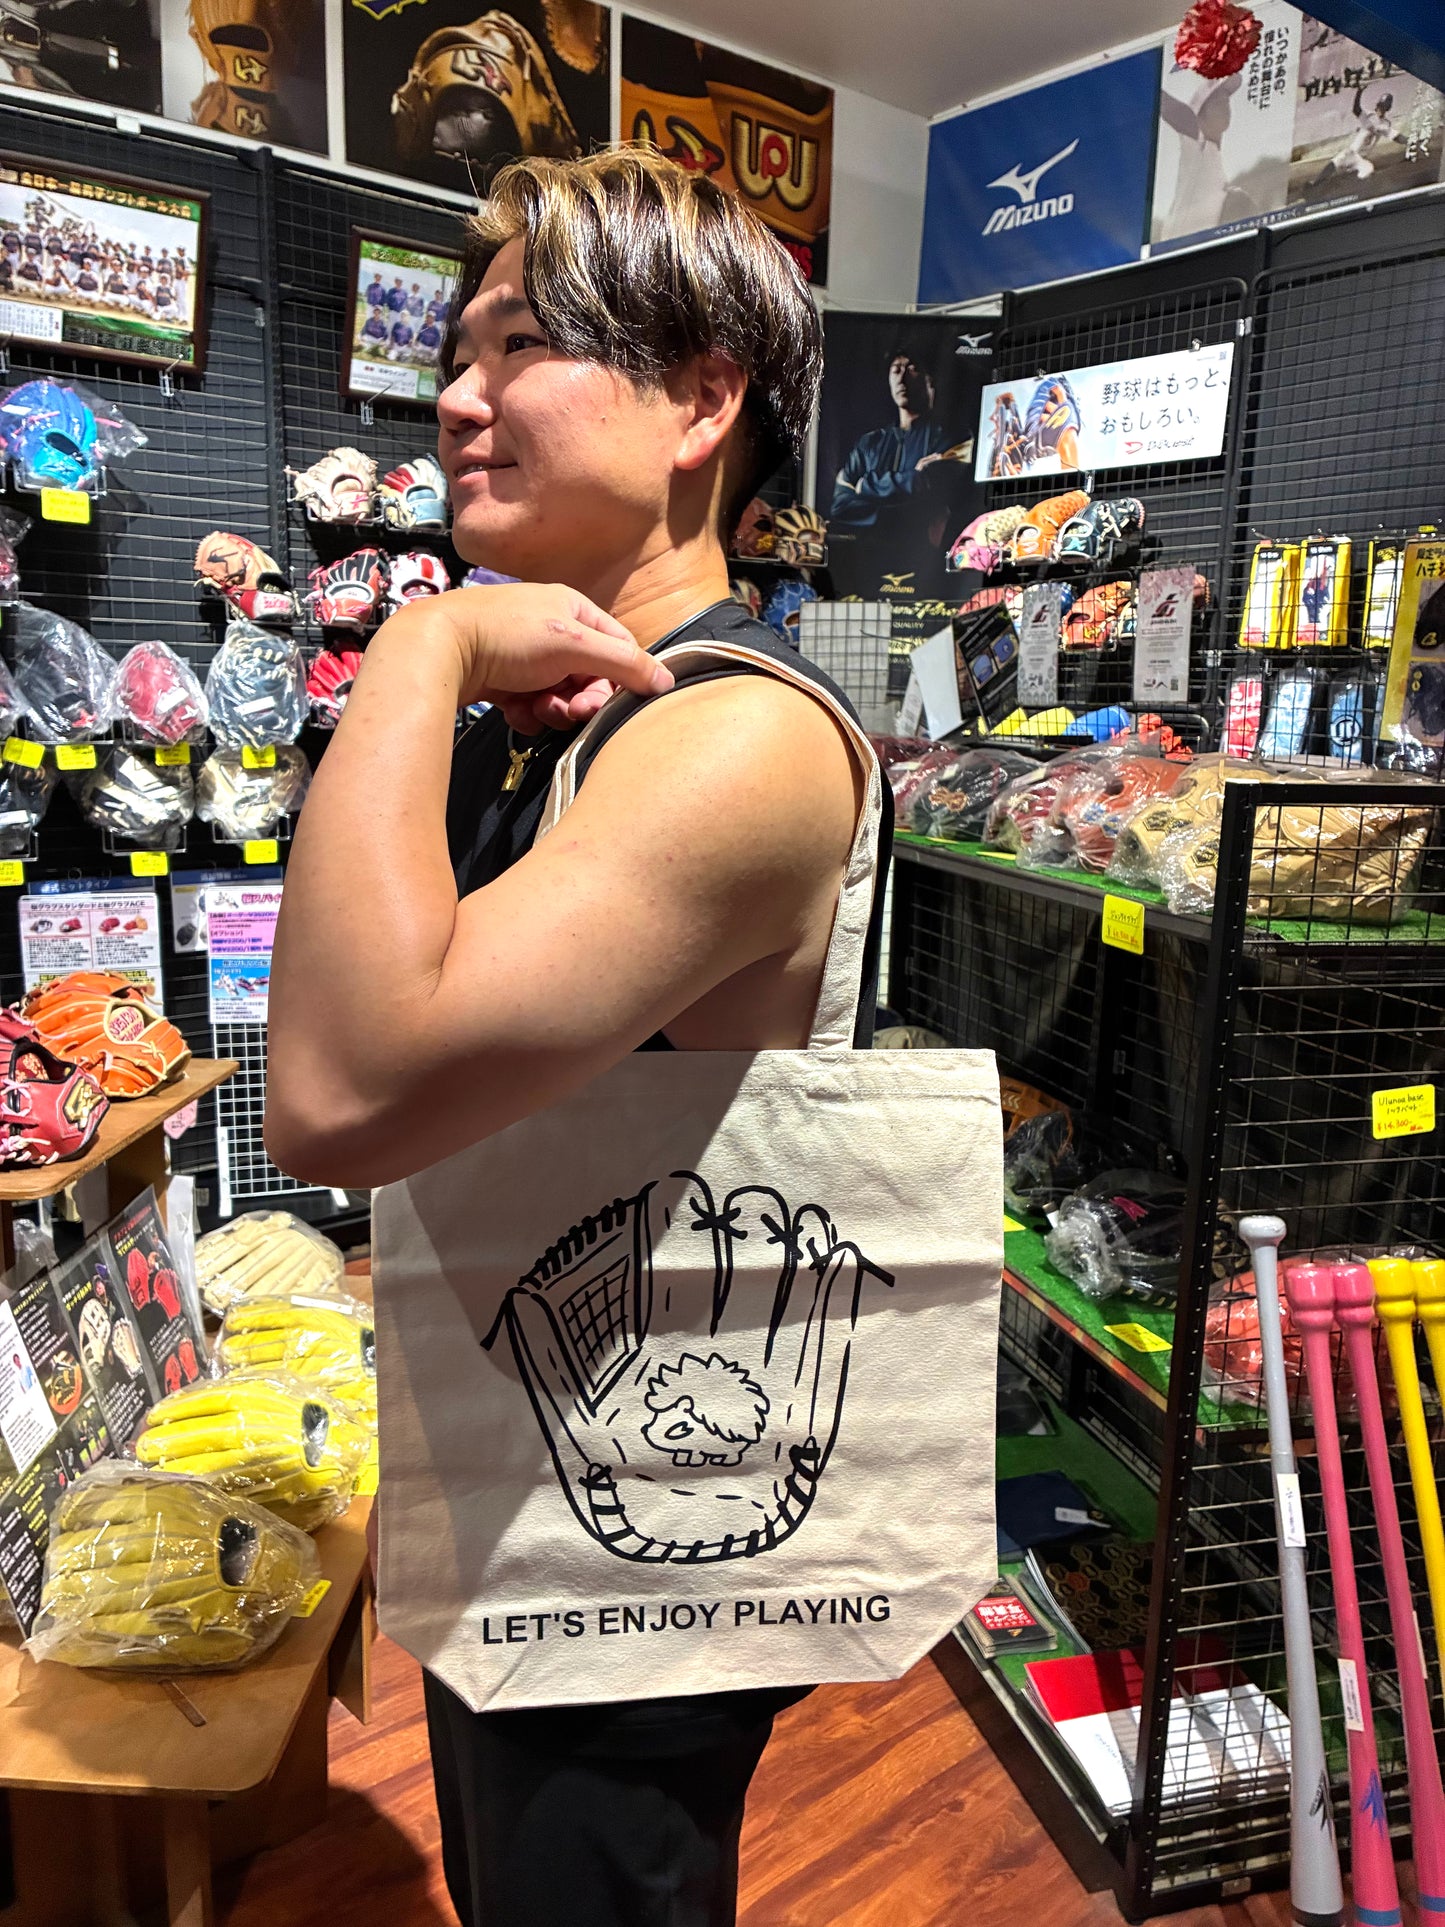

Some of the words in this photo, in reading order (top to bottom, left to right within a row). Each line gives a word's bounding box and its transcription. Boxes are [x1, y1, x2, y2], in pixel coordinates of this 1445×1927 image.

[981, 193, 1075, 236] MIZUNO
[1102, 367, 1228, 406] 野球はもっと、
[1099, 407, 1201, 435] おもしろい。
[482, 1611, 586, 1645] LET'S
[599, 1602, 721, 1636] ENJOY
[734, 1594, 891, 1627] PLAYING
